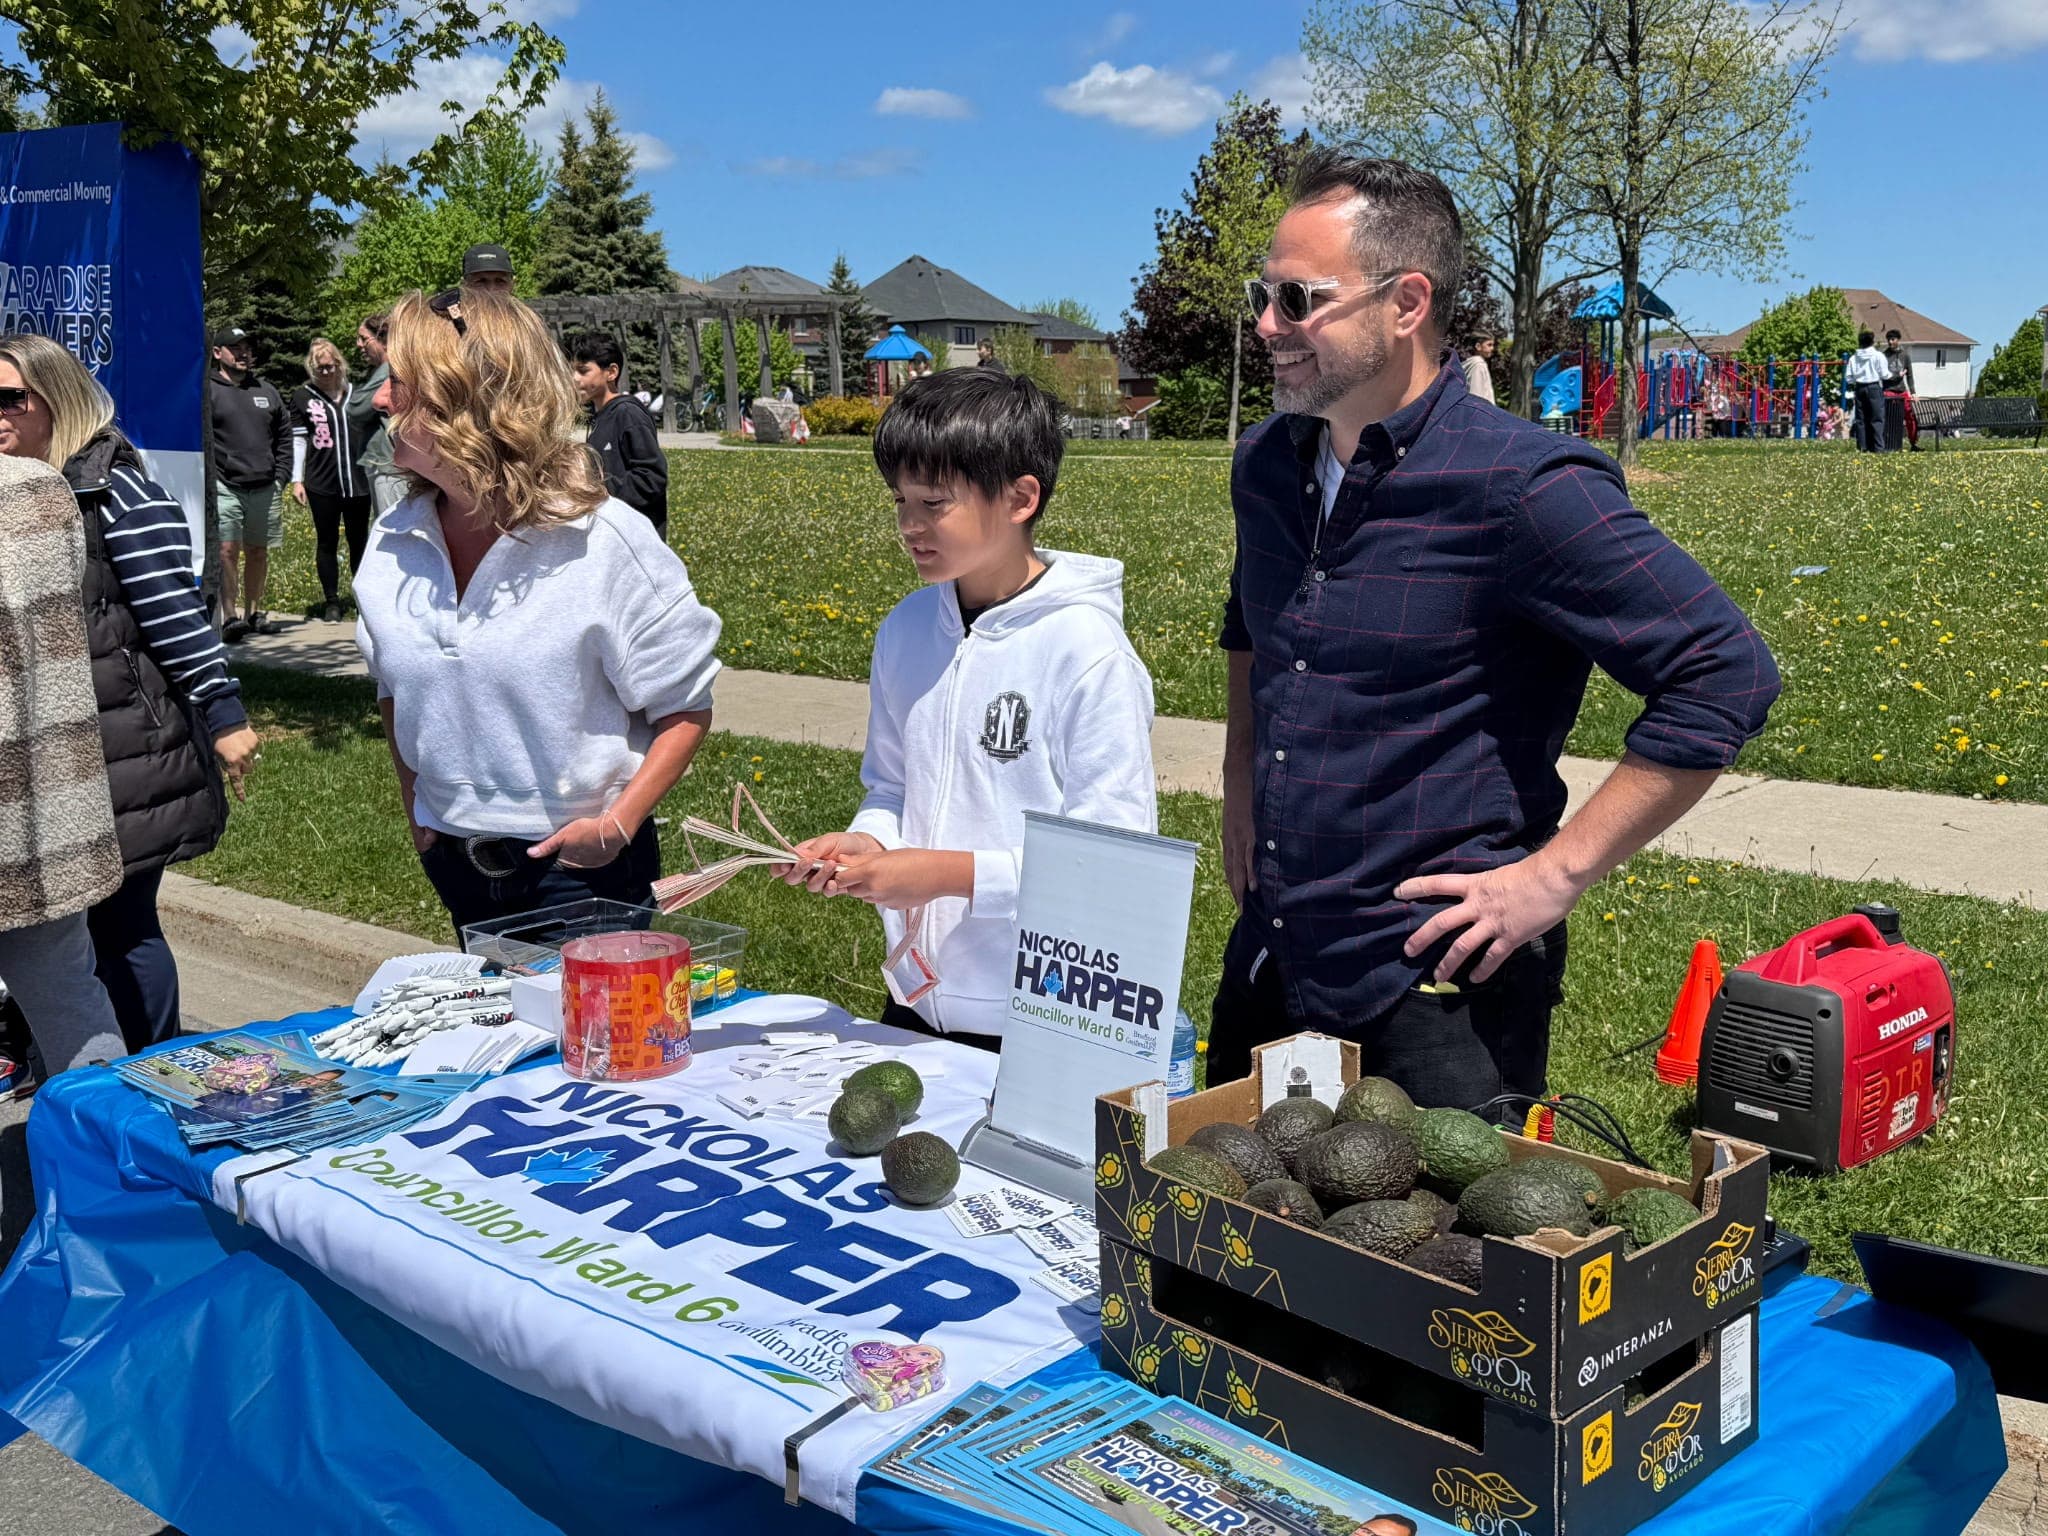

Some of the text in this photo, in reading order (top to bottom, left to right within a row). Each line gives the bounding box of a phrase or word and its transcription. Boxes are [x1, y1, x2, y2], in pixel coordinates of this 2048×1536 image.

[10, 182, 72, 204] Commercial
[73, 180, 112, 205] Moving
[1018, 928, 1120, 974] NICKOLAS
[1014, 950, 1164, 1031] HARPER
[471, 1012, 514, 1026] ARPER
[1012, 996, 1125, 1042] Councillor Ward 6
[1878, 1006, 1929, 1041] HONDA
[533, 1081, 891, 1214] NICKOLAS
[399, 1096, 1022, 1344] HARPER
[959, 1195, 1002, 1233] HARPER
[1004, 1196, 1054, 1219] ARPER
[328, 1148, 740, 1323] Councillor Ward 6
[1036, 1222, 1076, 1251] ARPER
[1051, 1264, 1100, 1292] HARP
[1693, 1247, 1735, 1297] SIERRA
[1718, 1256, 1755, 1292] D'OR
[1721, 1277, 1756, 1304] AVOCADO
[717, 1320, 841, 1382] Gwillimbury
[860, 1344, 894, 1361] Polly
[1427, 1309, 1499, 1361] SIERRA
[1601, 1317, 1673, 1370] INTERANZA
[1471, 1352, 1537, 1397] D'OR
[1475, 1377, 1538, 1408] AVOCADO
[1110, 1436, 1221, 1494] NICKOLAS
[1150, 1431, 1183, 1450] Door
[1180, 1446, 1196, 1458] to
[1195, 1453, 1231, 1474] Door
[1227, 1468, 1266, 1491] Meet
[1277, 1494, 1320, 1518] Greet
[1183, 1415, 1238, 1446] ANNUAL
[1242, 1444, 1284, 1465] 2025
[1287, 1465, 1353, 1498] UPDATE
[1637, 1428, 1683, 1482] SIERRA
[1665, 1434, 1704, 1474] D'OR
[1669, 1453, 1704, 1484] AVOCADO
[1065, 1458, 1148, 1505] Councillor
[1148, 1502, 1199, 1532] Ward
[1080, 1444, 1248, 1534] HARPER
[1432, 1467, 1502, 1520] SIERRA
[1474, 1512, 1533, 1536] D'O
